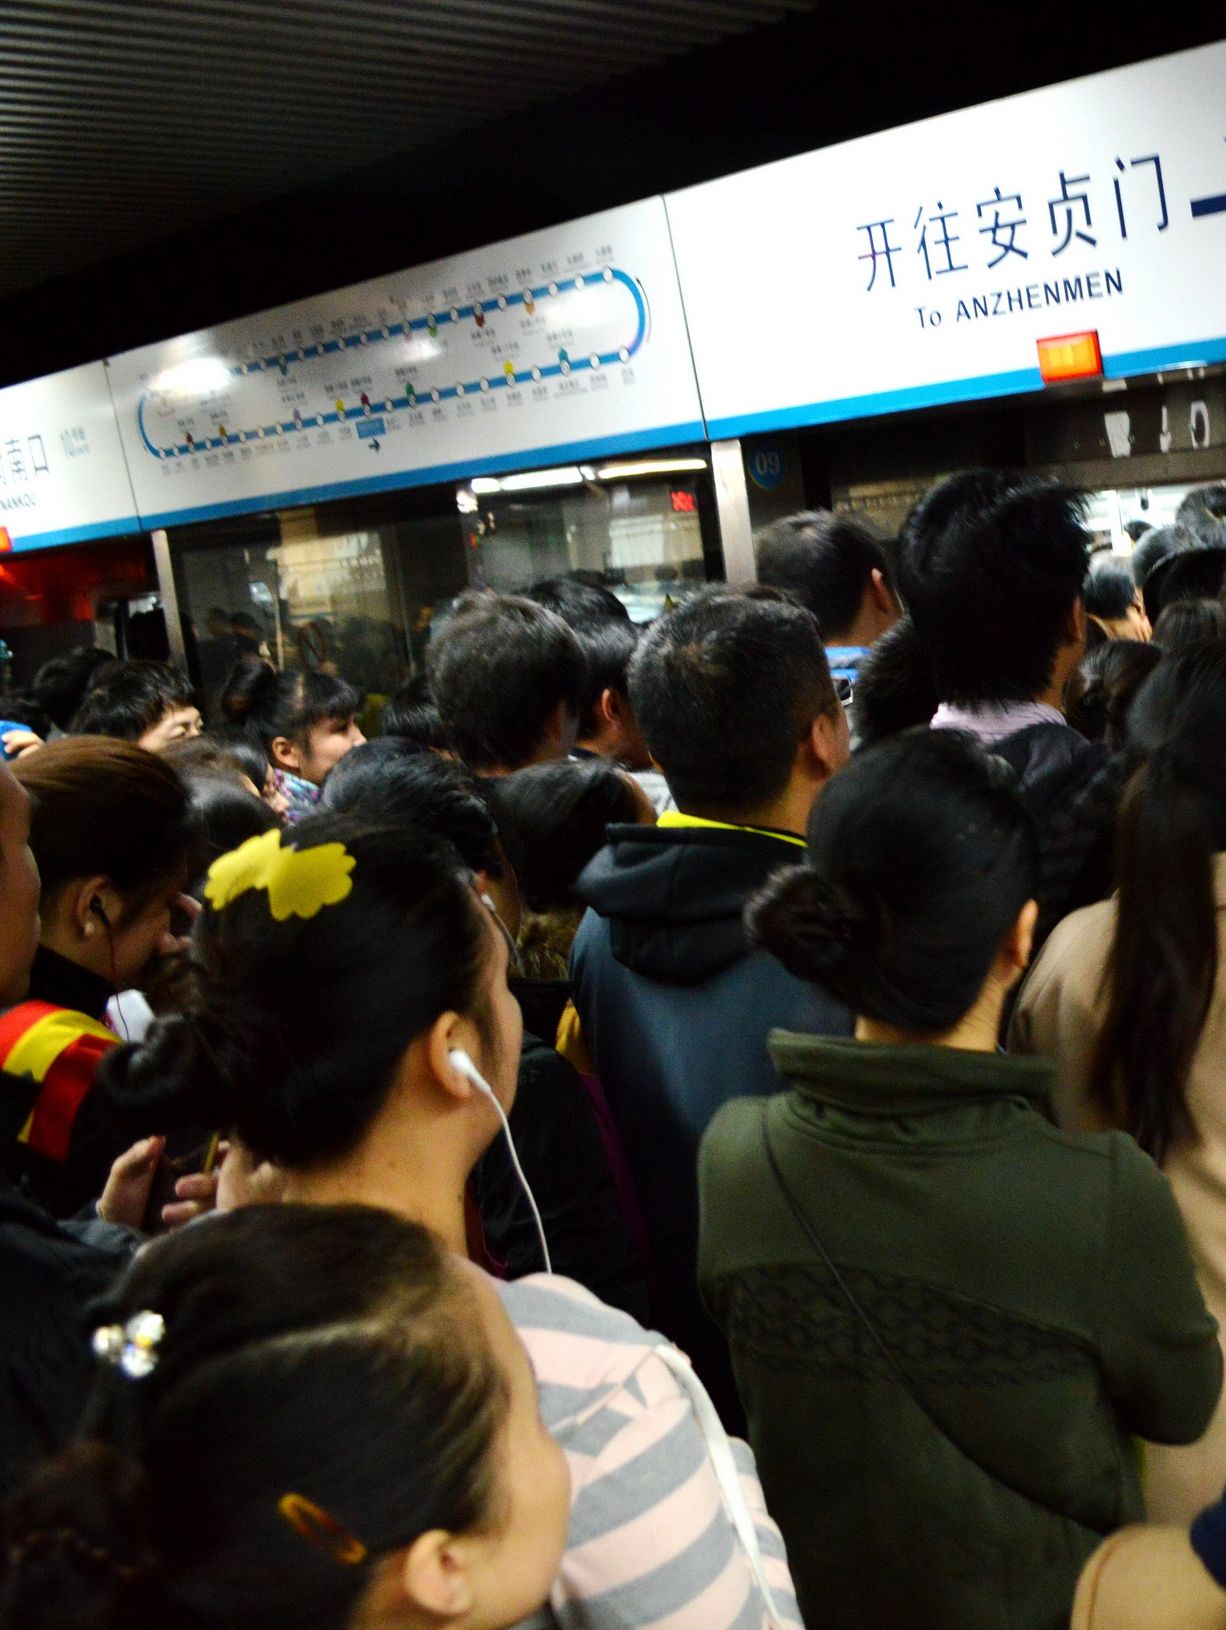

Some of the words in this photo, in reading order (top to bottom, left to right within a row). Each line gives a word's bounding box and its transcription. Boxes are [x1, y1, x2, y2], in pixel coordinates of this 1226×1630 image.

[856, 153, 1171, 292] 开往安贞门
[914, 305, 943, 330] To
[956, 268, 1125, 321] ANZHENMEN
[755, 452, 781, 476] 09
